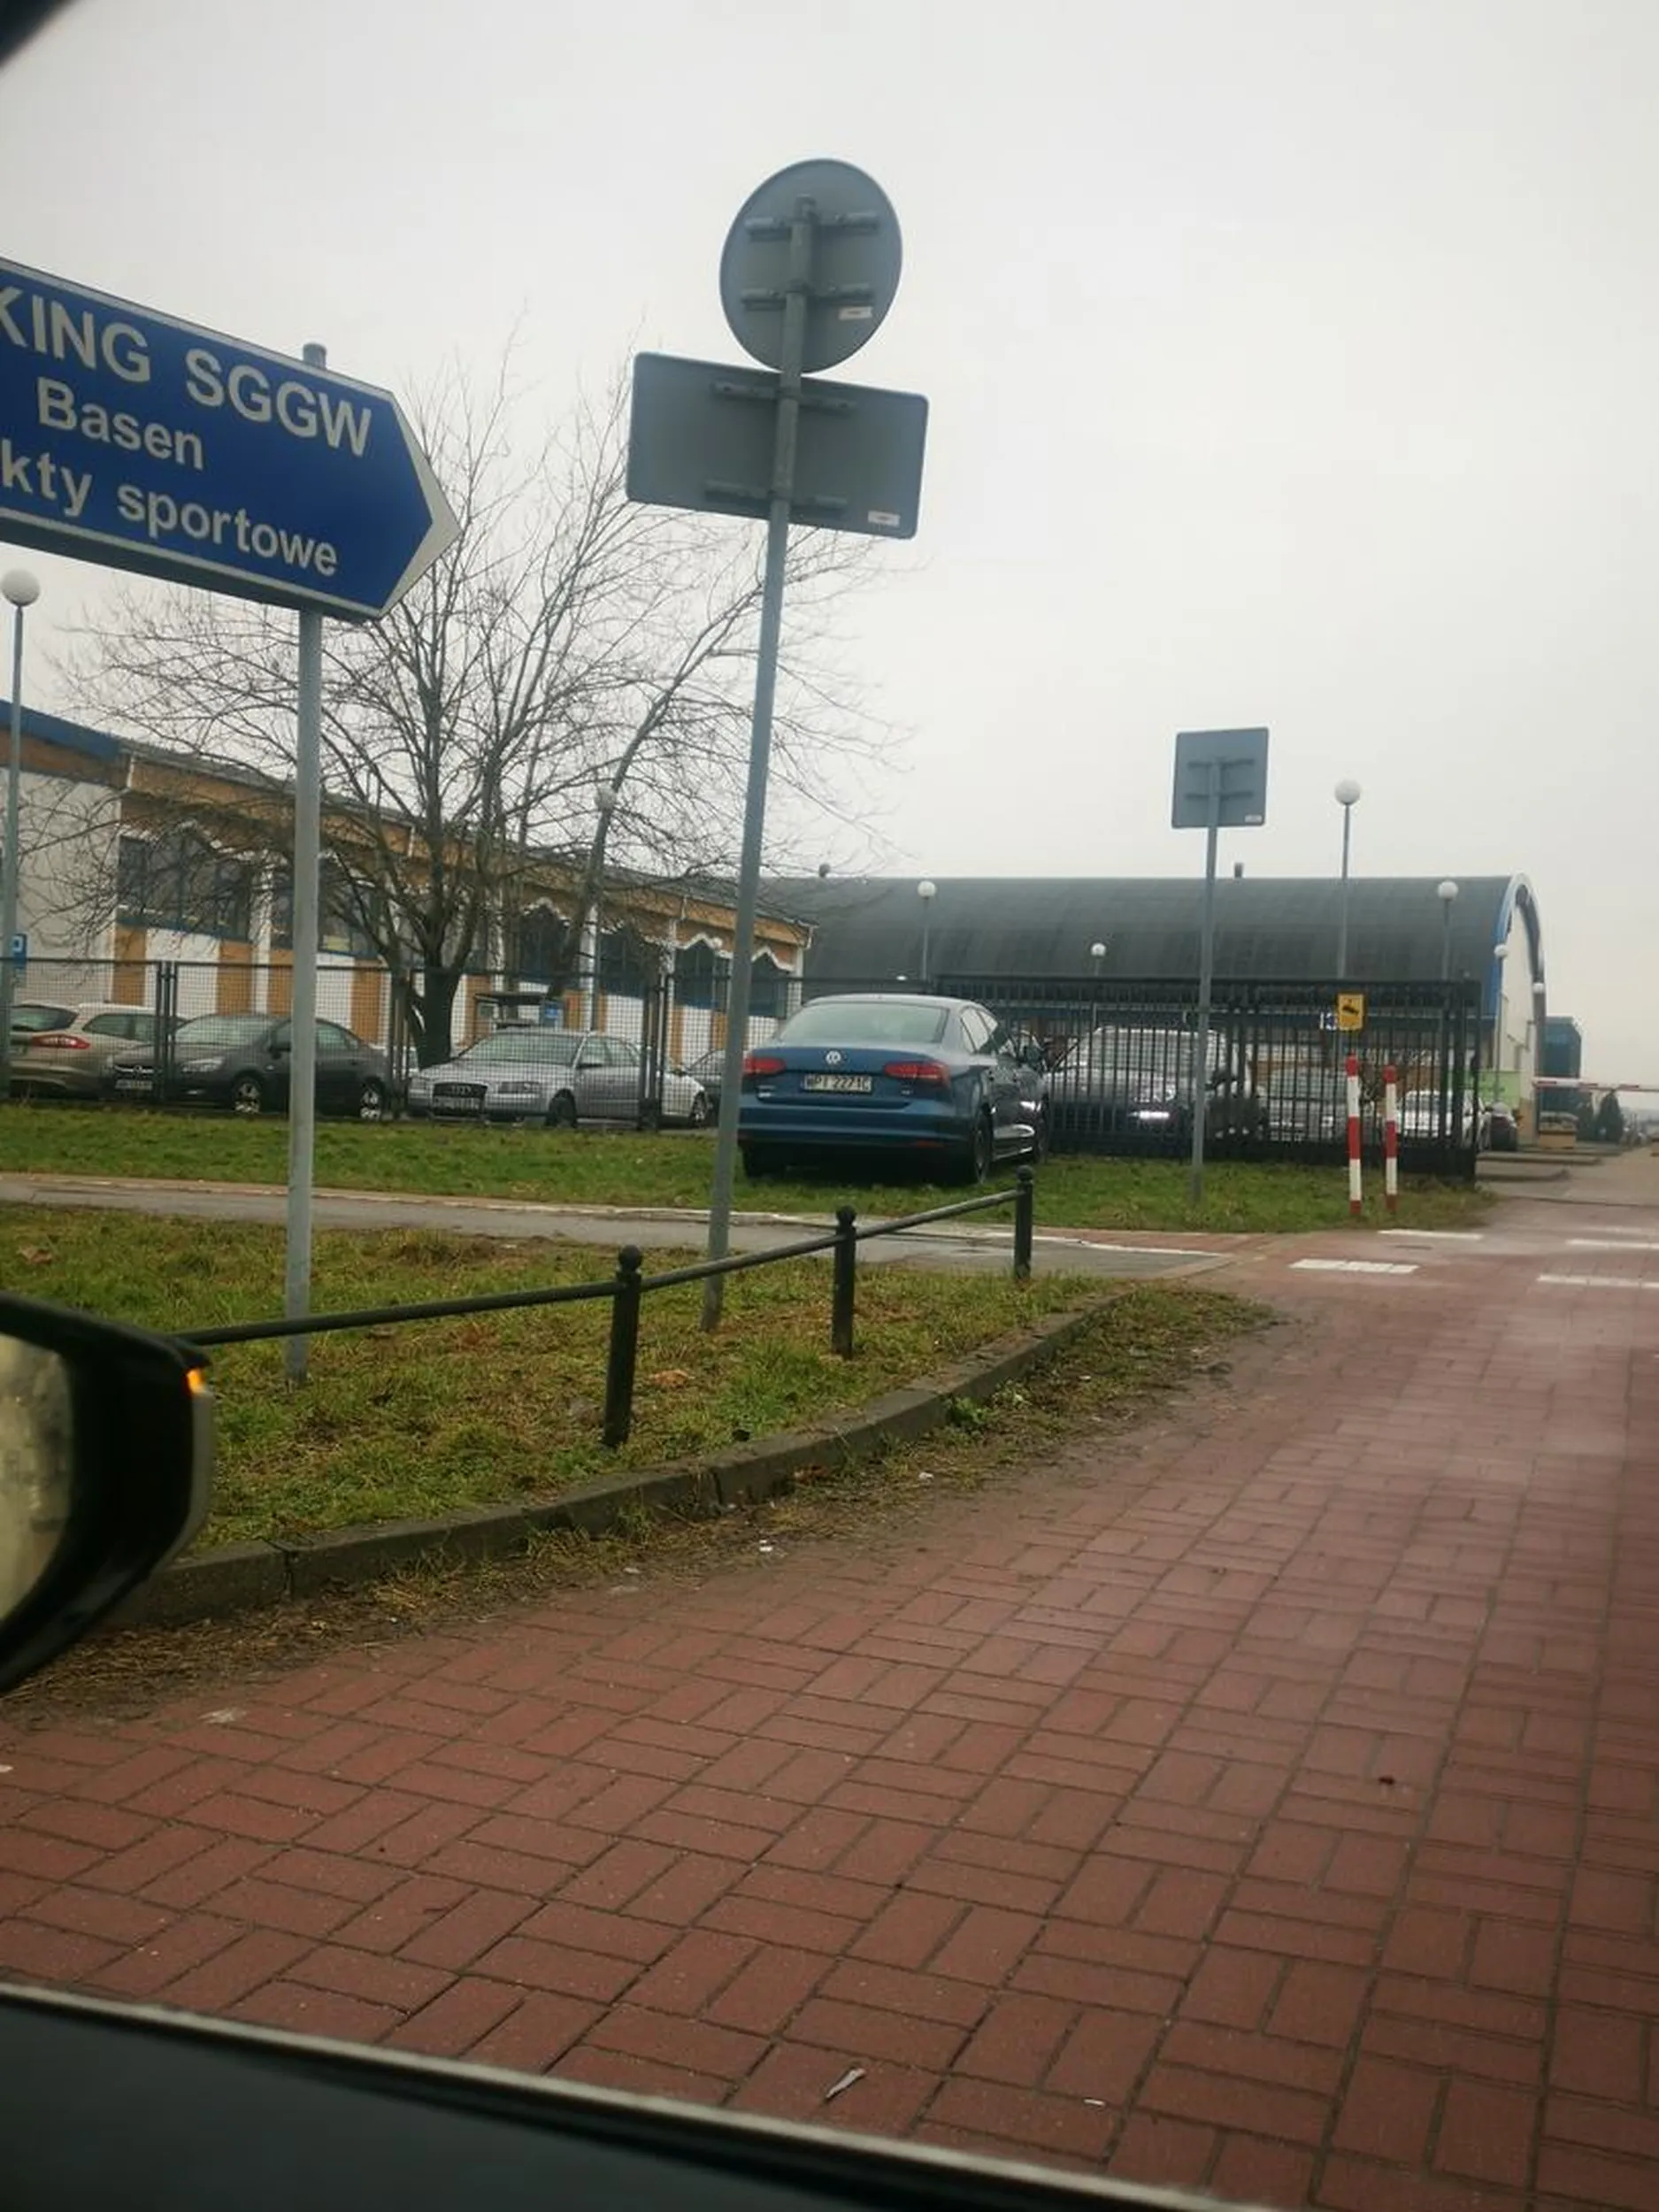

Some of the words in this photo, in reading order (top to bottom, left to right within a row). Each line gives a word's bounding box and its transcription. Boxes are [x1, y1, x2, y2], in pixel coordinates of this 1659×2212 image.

[0, 287, 151, 382] KING
[186, 349, 372, 457] SGGW
[37, 377, 204, 471] Basen
[2, 439, 93, 517] kty
[117, 484, 338, 576] sportowe
